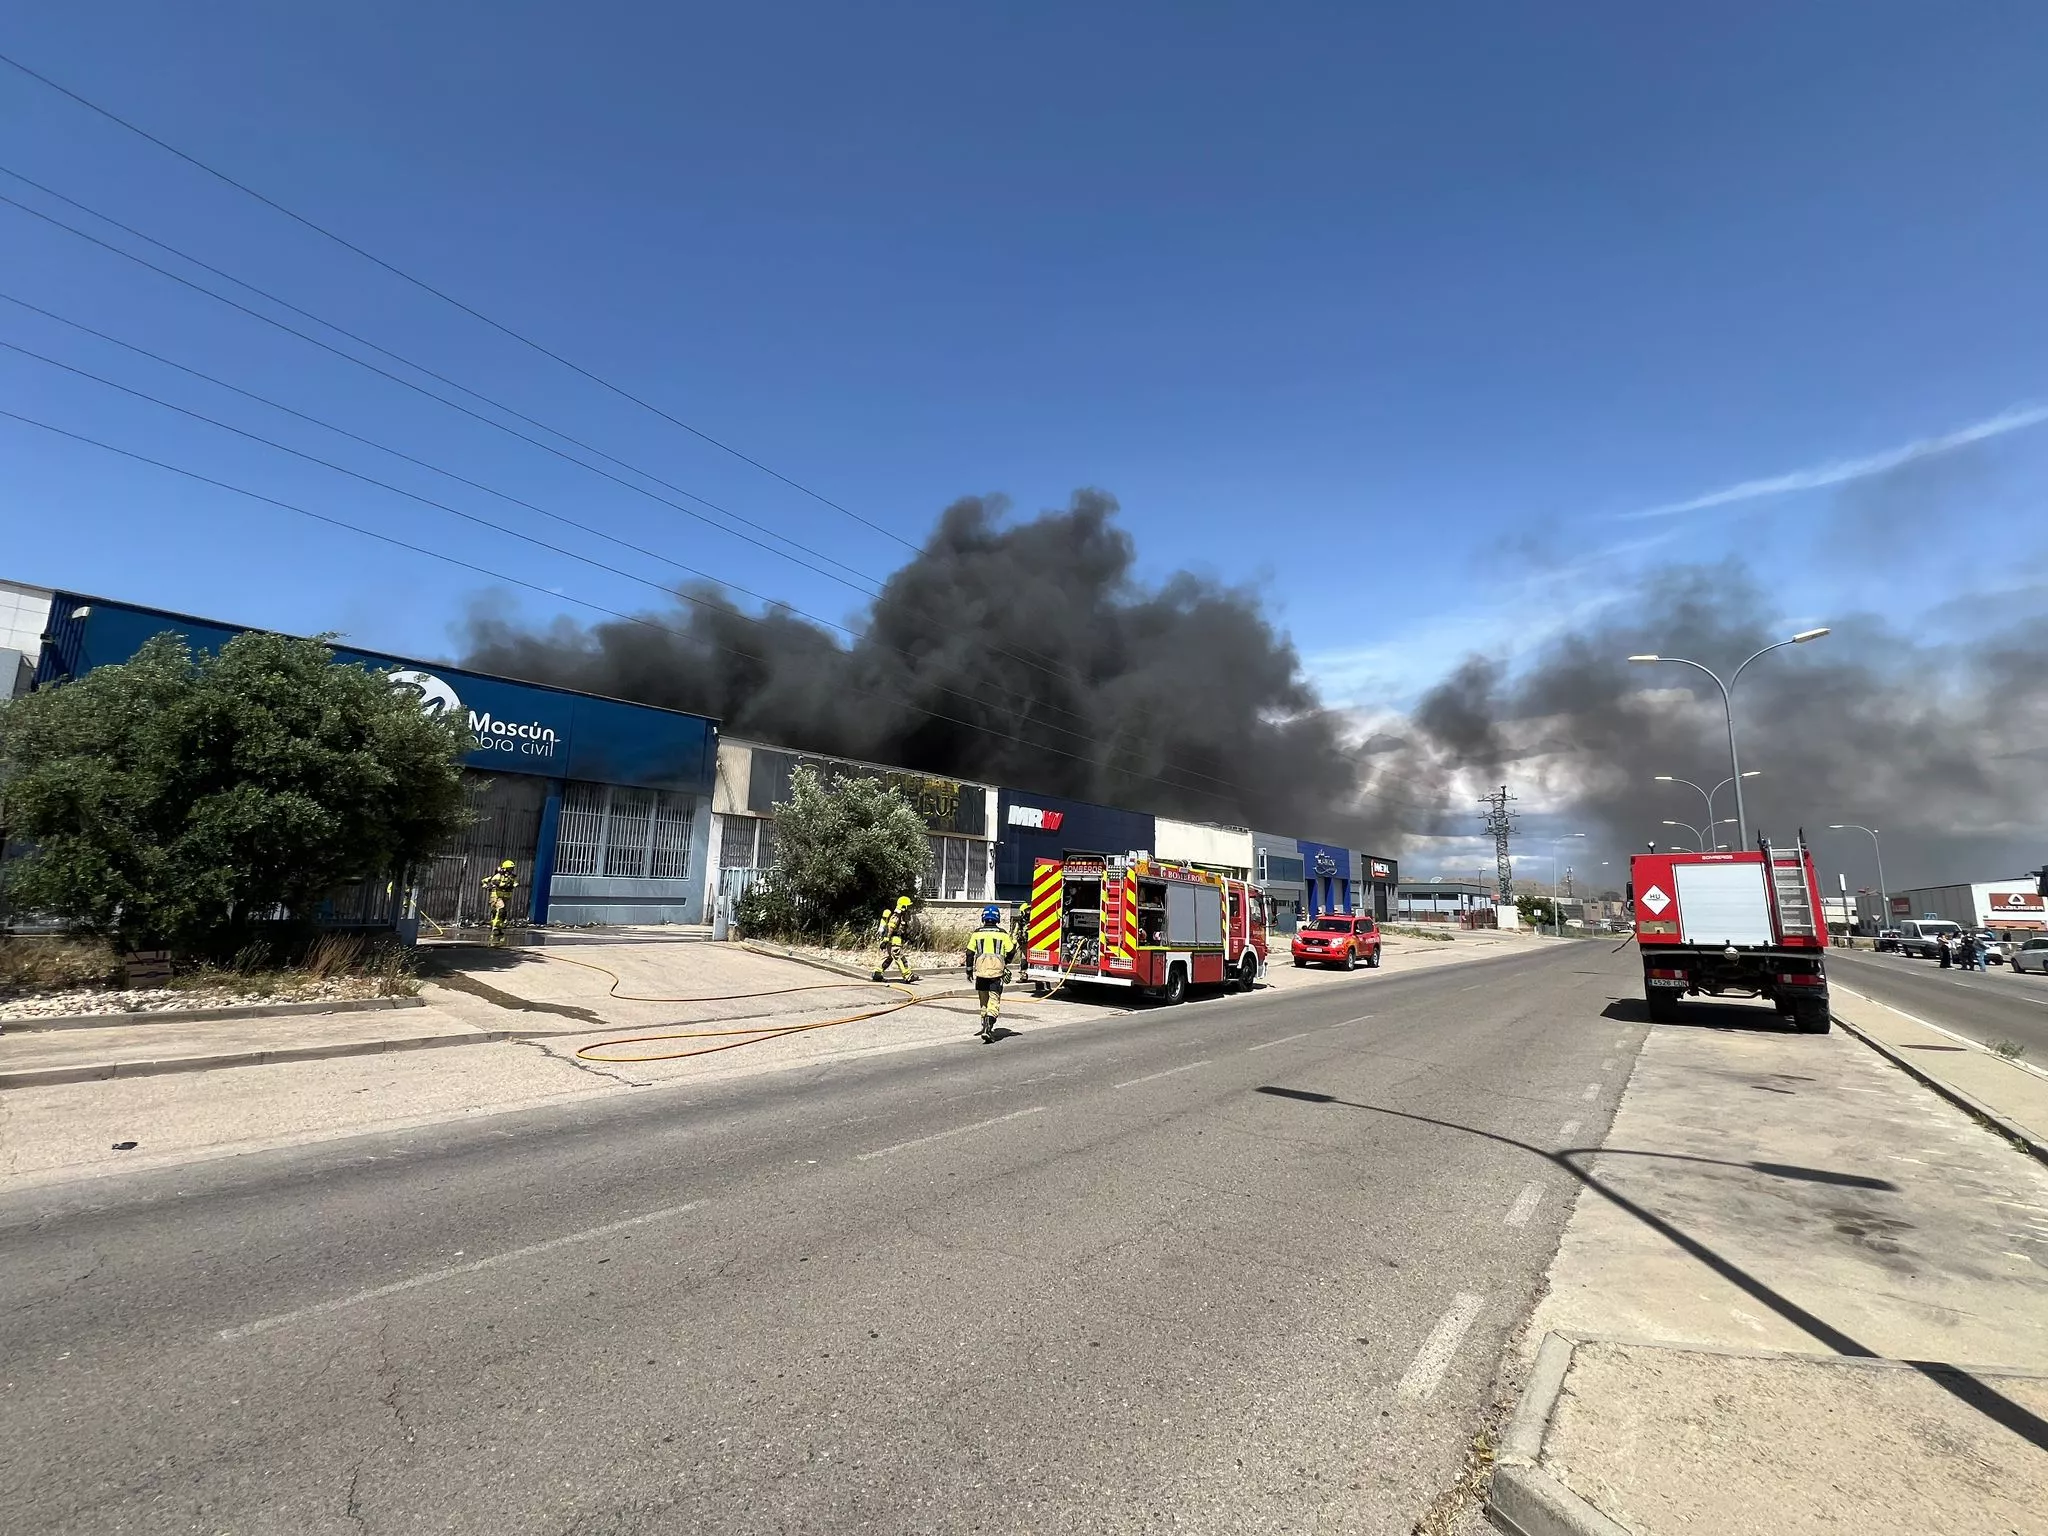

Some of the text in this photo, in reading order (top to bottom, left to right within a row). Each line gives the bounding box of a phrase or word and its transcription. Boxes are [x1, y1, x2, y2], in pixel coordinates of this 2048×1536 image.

[469, 710, 556, 741] Mascún
[521, 739, 555, 757] civil
[1007, 804, 1064, 830] MRW
[1063, 865, 1103, 874] BOMBEROS
[1167, 870, 1204, 882] BOMBEROS
